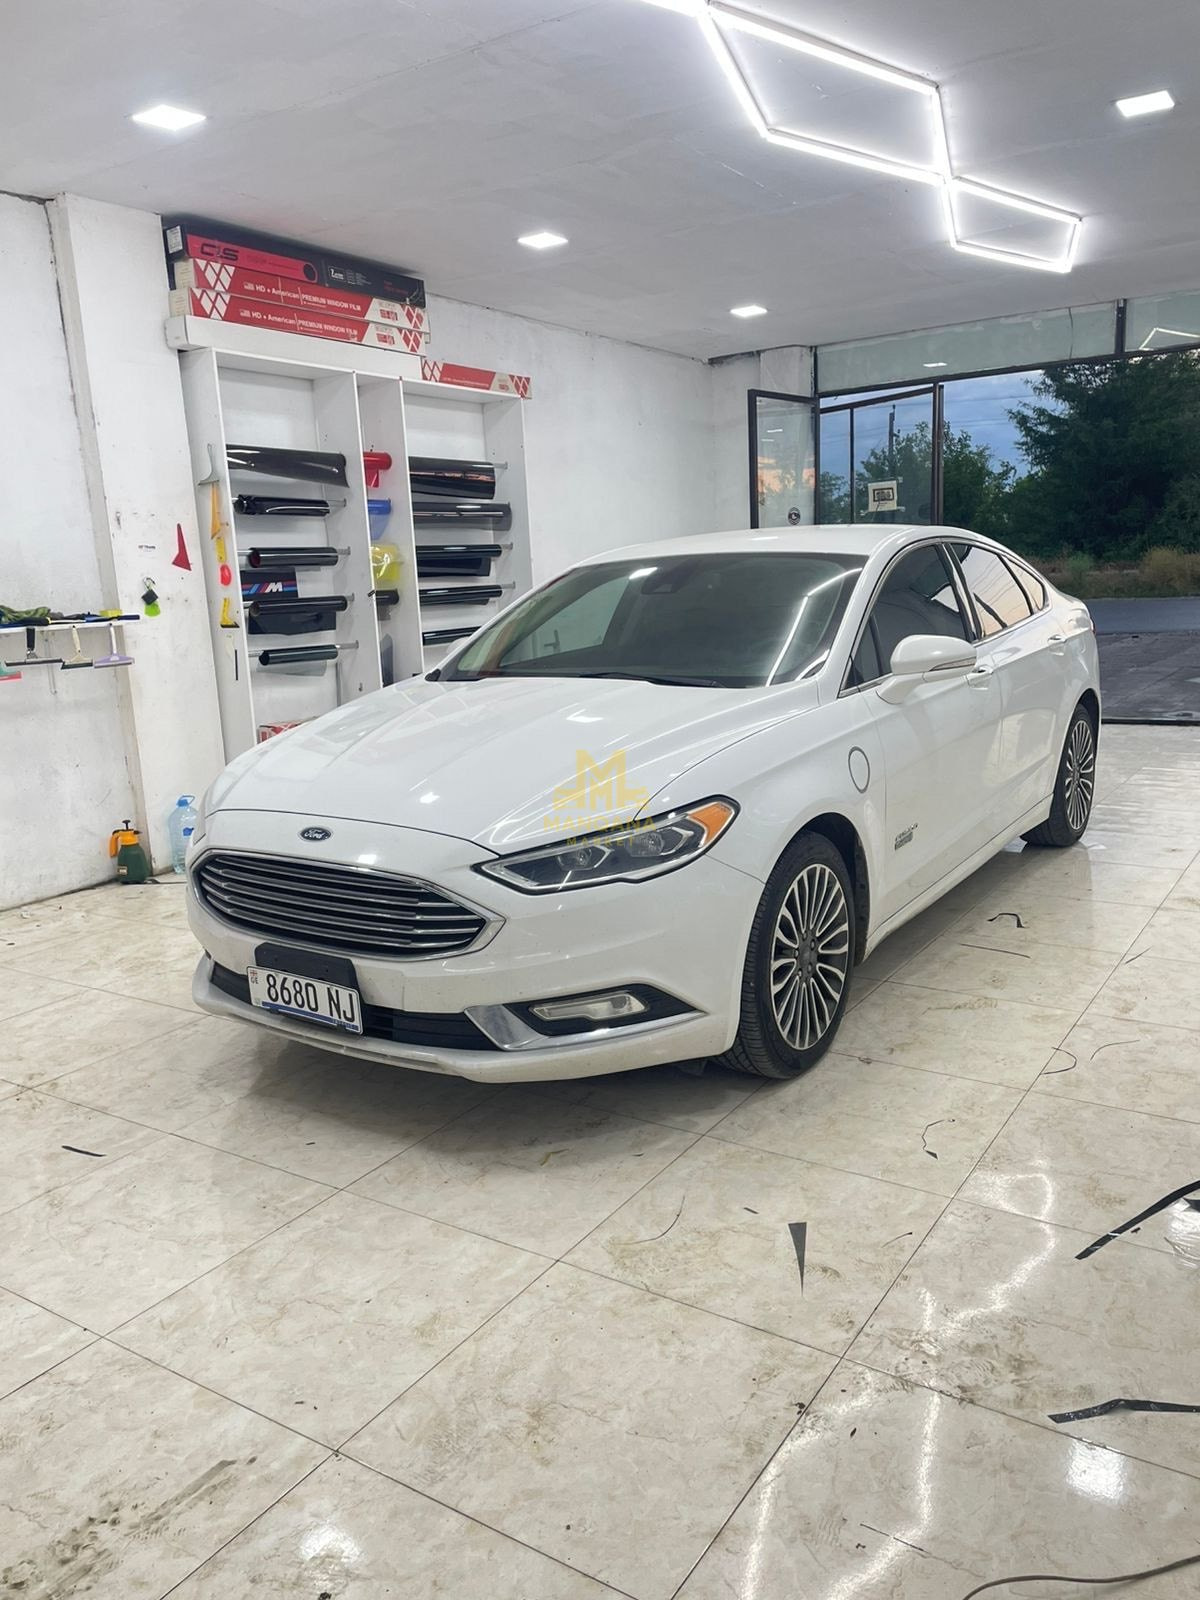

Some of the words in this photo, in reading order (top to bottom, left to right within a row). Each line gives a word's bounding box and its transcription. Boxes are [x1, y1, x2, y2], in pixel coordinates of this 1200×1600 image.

[255, 284, 266, 293] HD
[271, 287, 300, 299] American
[251, 311, 262, 319] HD
[267, 314, 296, 325] American
[304, 828, 327, 840] Ford
[266, 973, 319, 1012] 8680
[326, 986, 355, 1023] NJ
